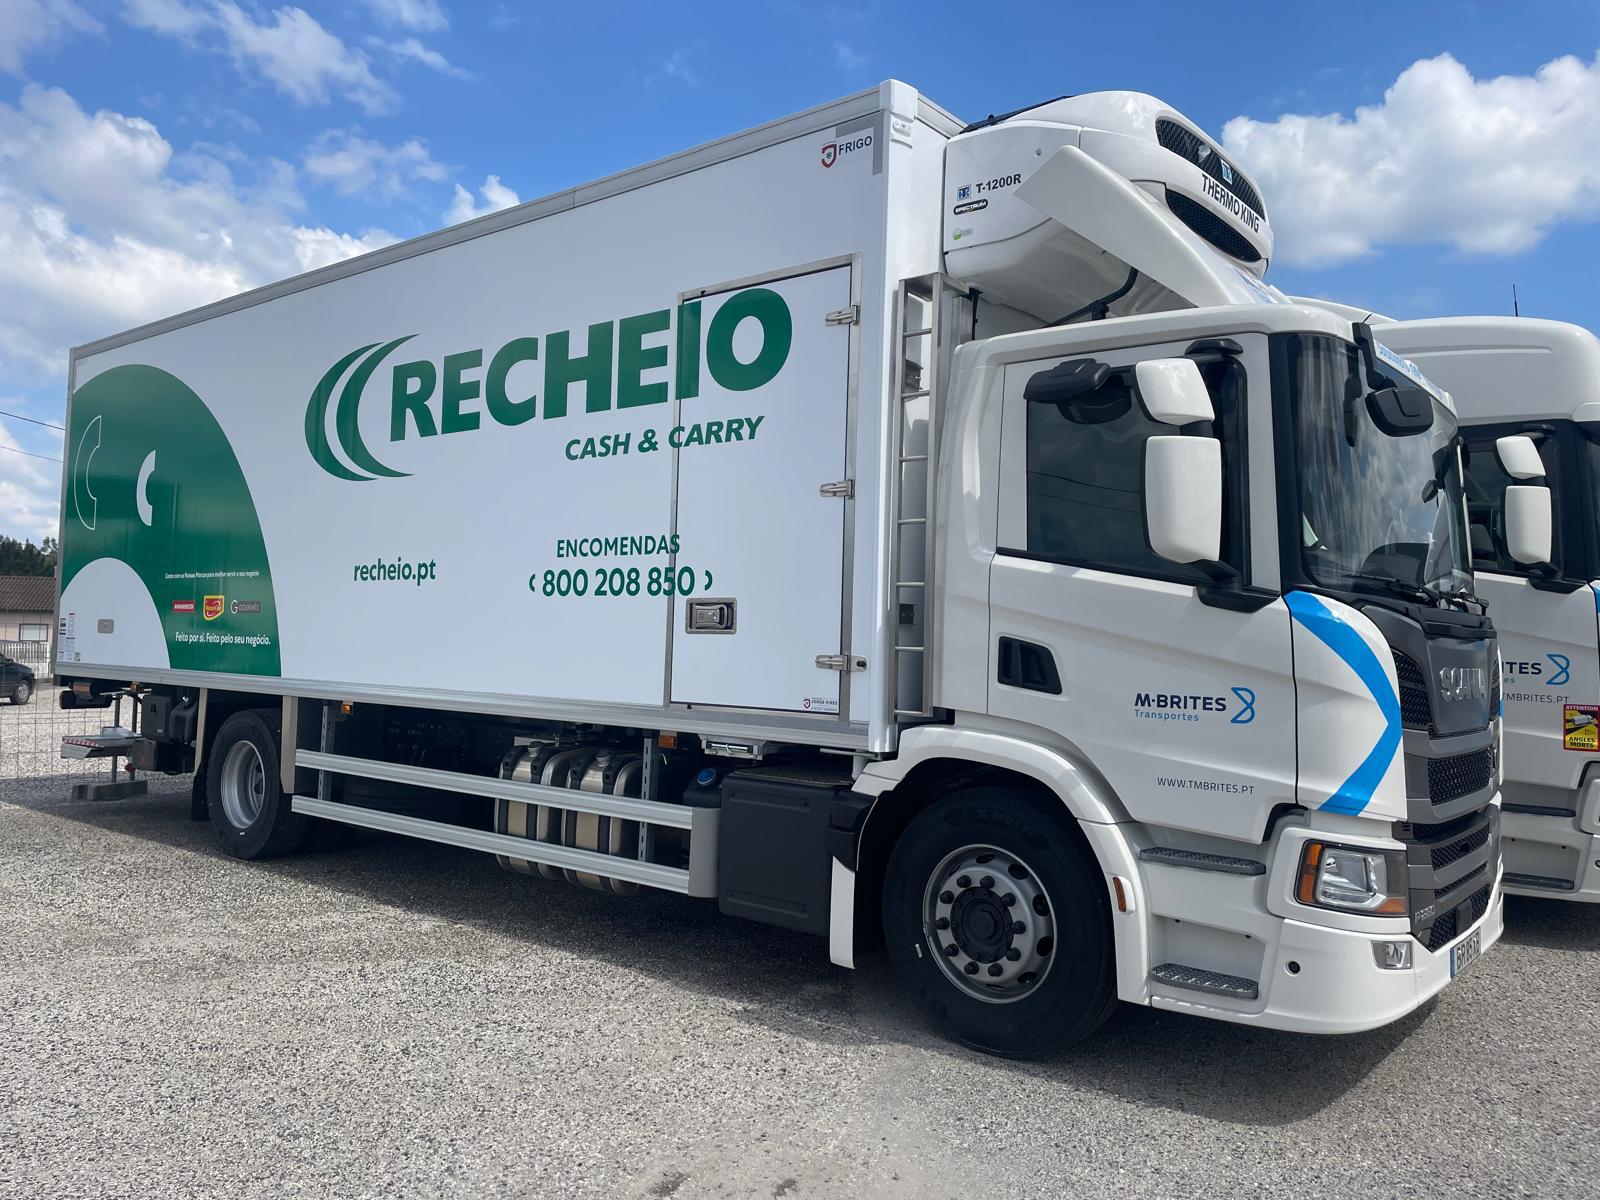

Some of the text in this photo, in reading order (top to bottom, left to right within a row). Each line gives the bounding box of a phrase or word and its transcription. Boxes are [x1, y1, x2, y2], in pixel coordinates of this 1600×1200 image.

[838, 135, 873, 156] FRIGO
[975, 173, 1022, 194] T-1200R
[1201, 173, 1260, 234] THERMO KING
[390, 287, 793, 442] RECHEIO
[565, 415, 765, 461] CASH & CARRY
[556, 532, 680, 558] ENCOMENDAS
[353, 558, 436, 586] recheio.pt
[542, 565, 696, 597] 800 208 850
[175, 631, 189, 642] Feito
[189, 635, 199, 645] por
[206, 632, 220, 644] Feito
[220, 633, 233, 646] pelo
[234, 636, 245, 645] seu
[245, 633, 271, 648] negócio.
[1503, 692, 1569, 704] MBRITES.PT
[1134, 709, 1200, 722] Transportes
[1157, 777, 1255, 795] WWW.TMBRITES.PT
